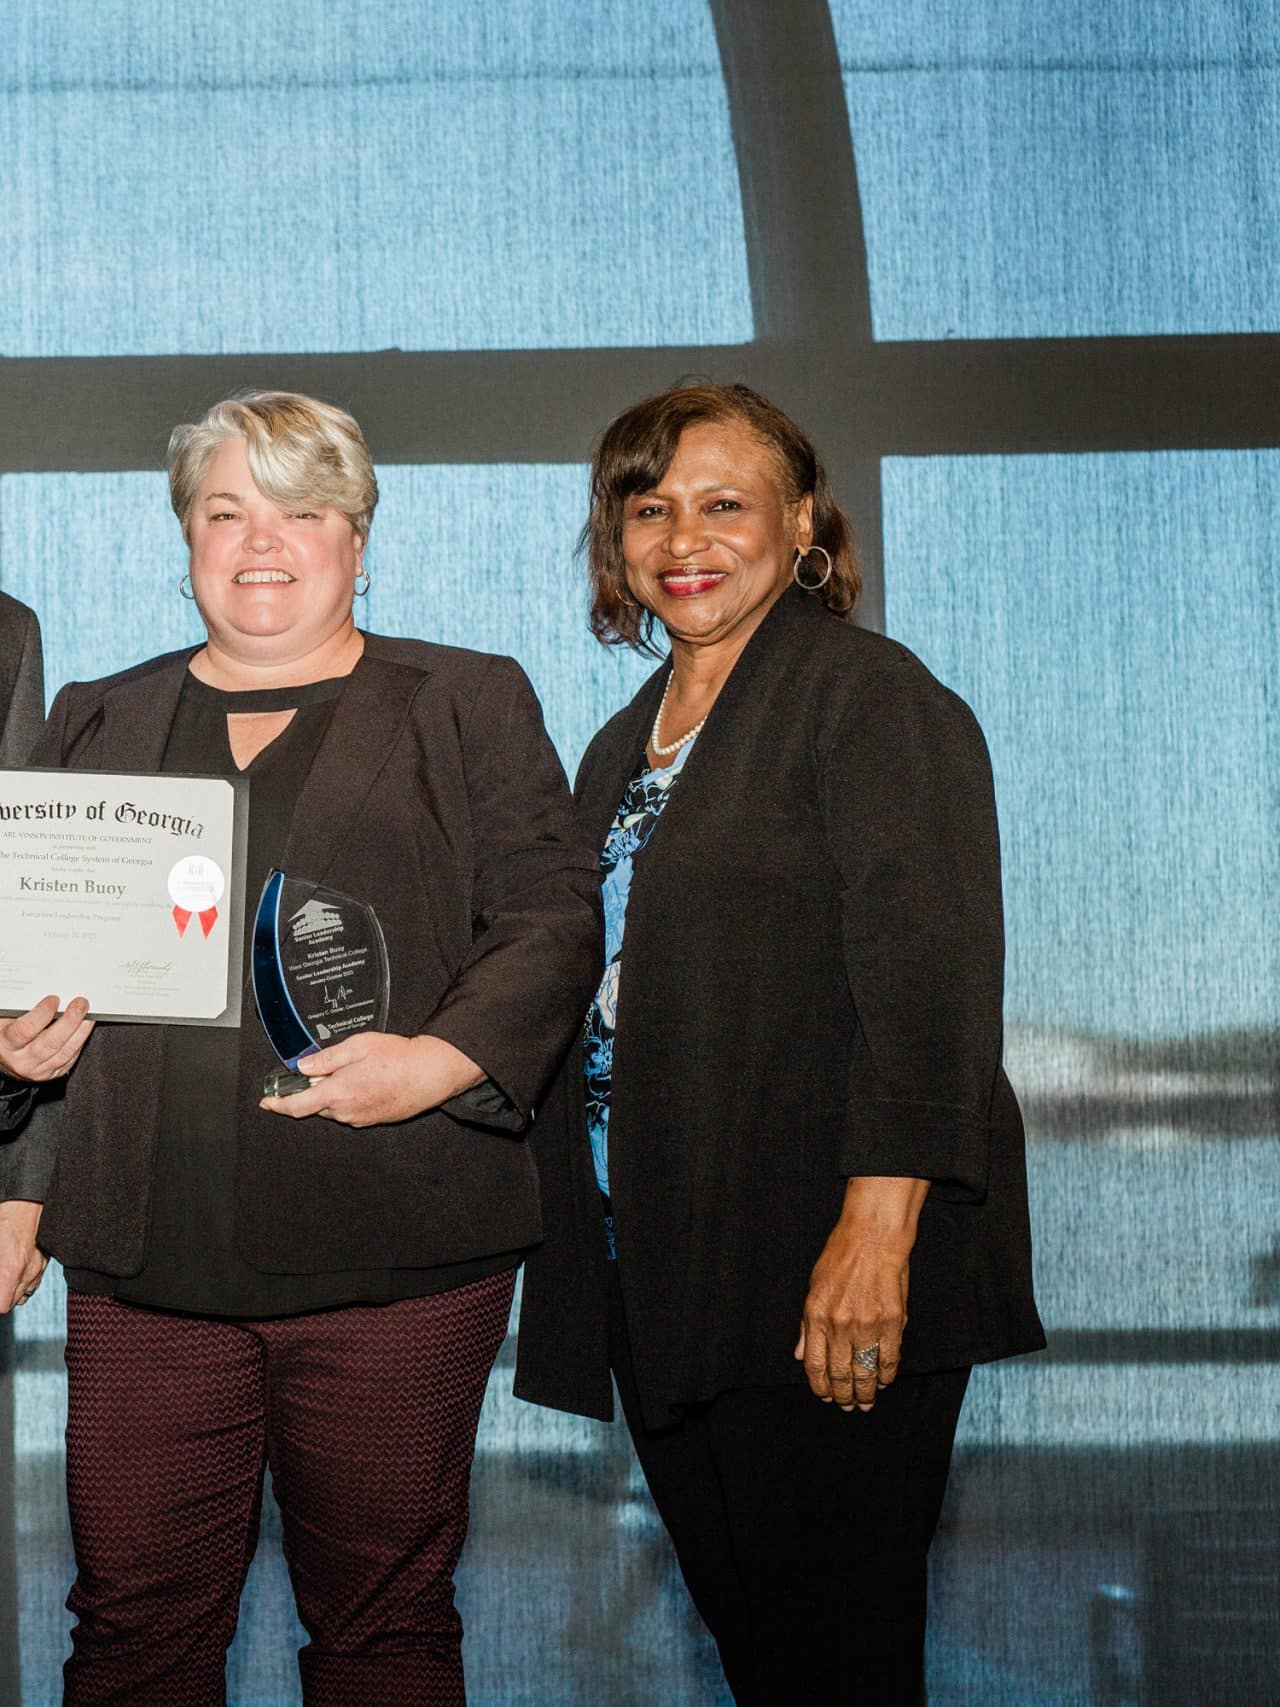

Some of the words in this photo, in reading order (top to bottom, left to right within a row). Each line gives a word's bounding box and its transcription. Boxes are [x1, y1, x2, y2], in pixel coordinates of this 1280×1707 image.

[85, 800, 107, 821] of
[114, 801, 205, 839] Georgia
[17, 831, 49, 840] VINSON
[49, 832, 85, 841] INSTITUTE
[87, 833, 99, 841] OF
[99, 834, 153, 845] GOVERNMENT
[12, 850, 49, 861] Technical
[50, 852, 80, 864] College
[81, 854, 110, 864] System
[110, 855, 120, 863] of
[121, 855, 153, 867] Georgia
[19, 876, 79, 893] Kristen
[85, 879, 128, 899] Buoy
[314, 927, 344, 937] Leadership
[308, 936, 334, 945] Academy
[308, 950, 328, 959] Kristen
[314, 966, 342, 976] Leadership
[328, 1018, 352, 1028] Technical
[354, 1015, 374, 1023] College
